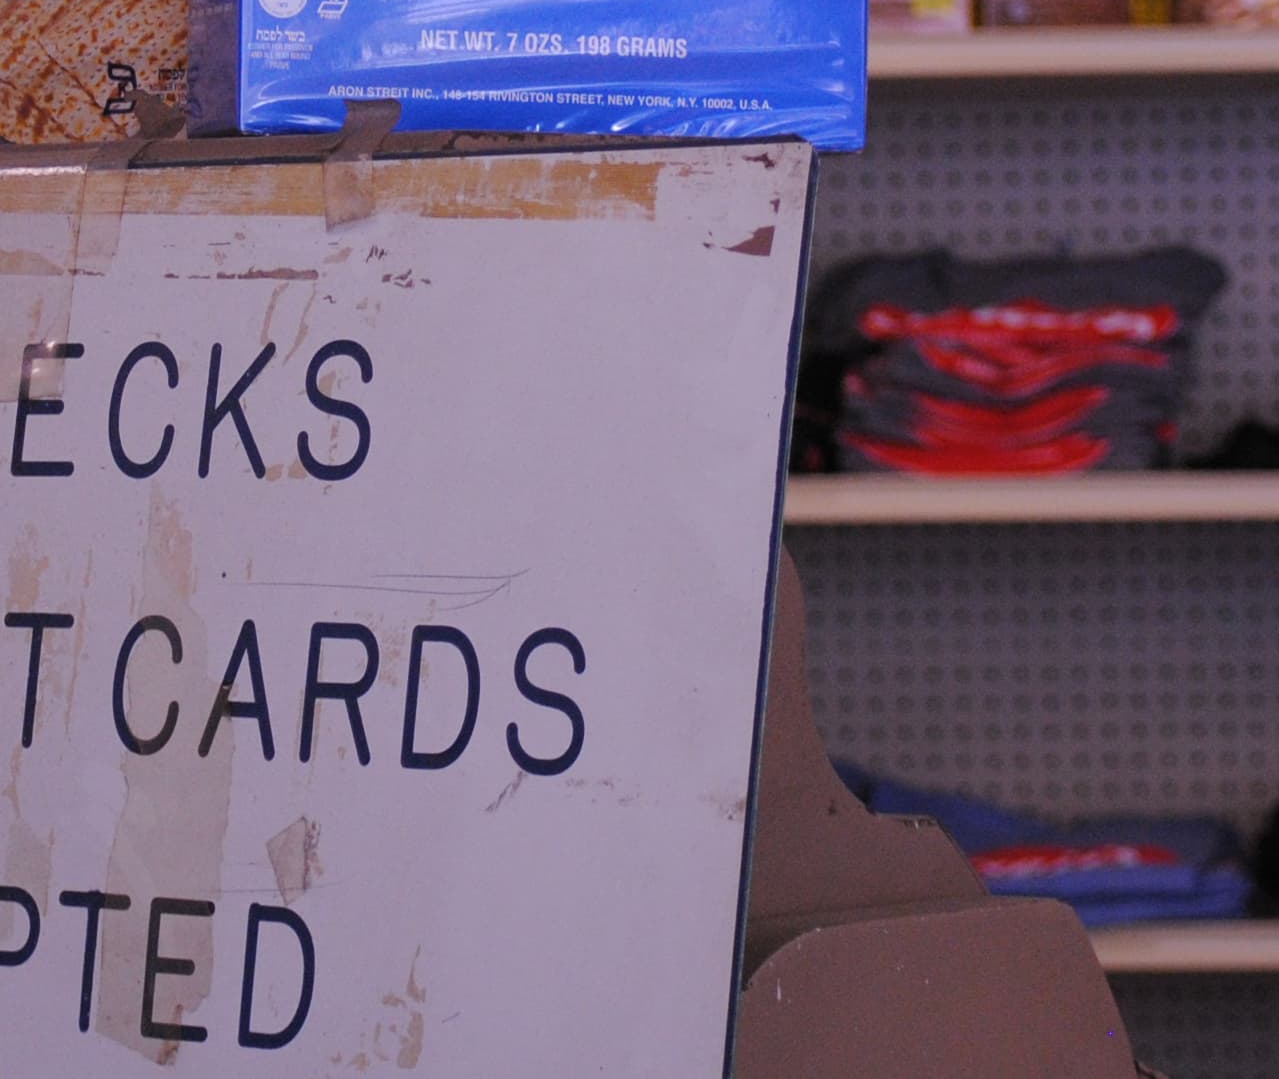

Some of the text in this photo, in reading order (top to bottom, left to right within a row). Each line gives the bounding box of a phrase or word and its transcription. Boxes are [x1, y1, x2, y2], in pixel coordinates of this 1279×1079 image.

[506, 32, 518, 53] 7
[524, 32, 569, 55] OZS.
[576, 34, 610, 56] 198
[616, 36, 688, 59] GRAMS
[328, 85, 364, 97] ARON
[366, 86, 409, 99] STREIT
[412, 88, 439, 100] INC.,
[488, 91, 554, 103] RIVINGTON
[607, 94, 635, 106] NEW
[677, 97, 698, 109] N.Y.
[111, 614, 587, 777] CARDS
